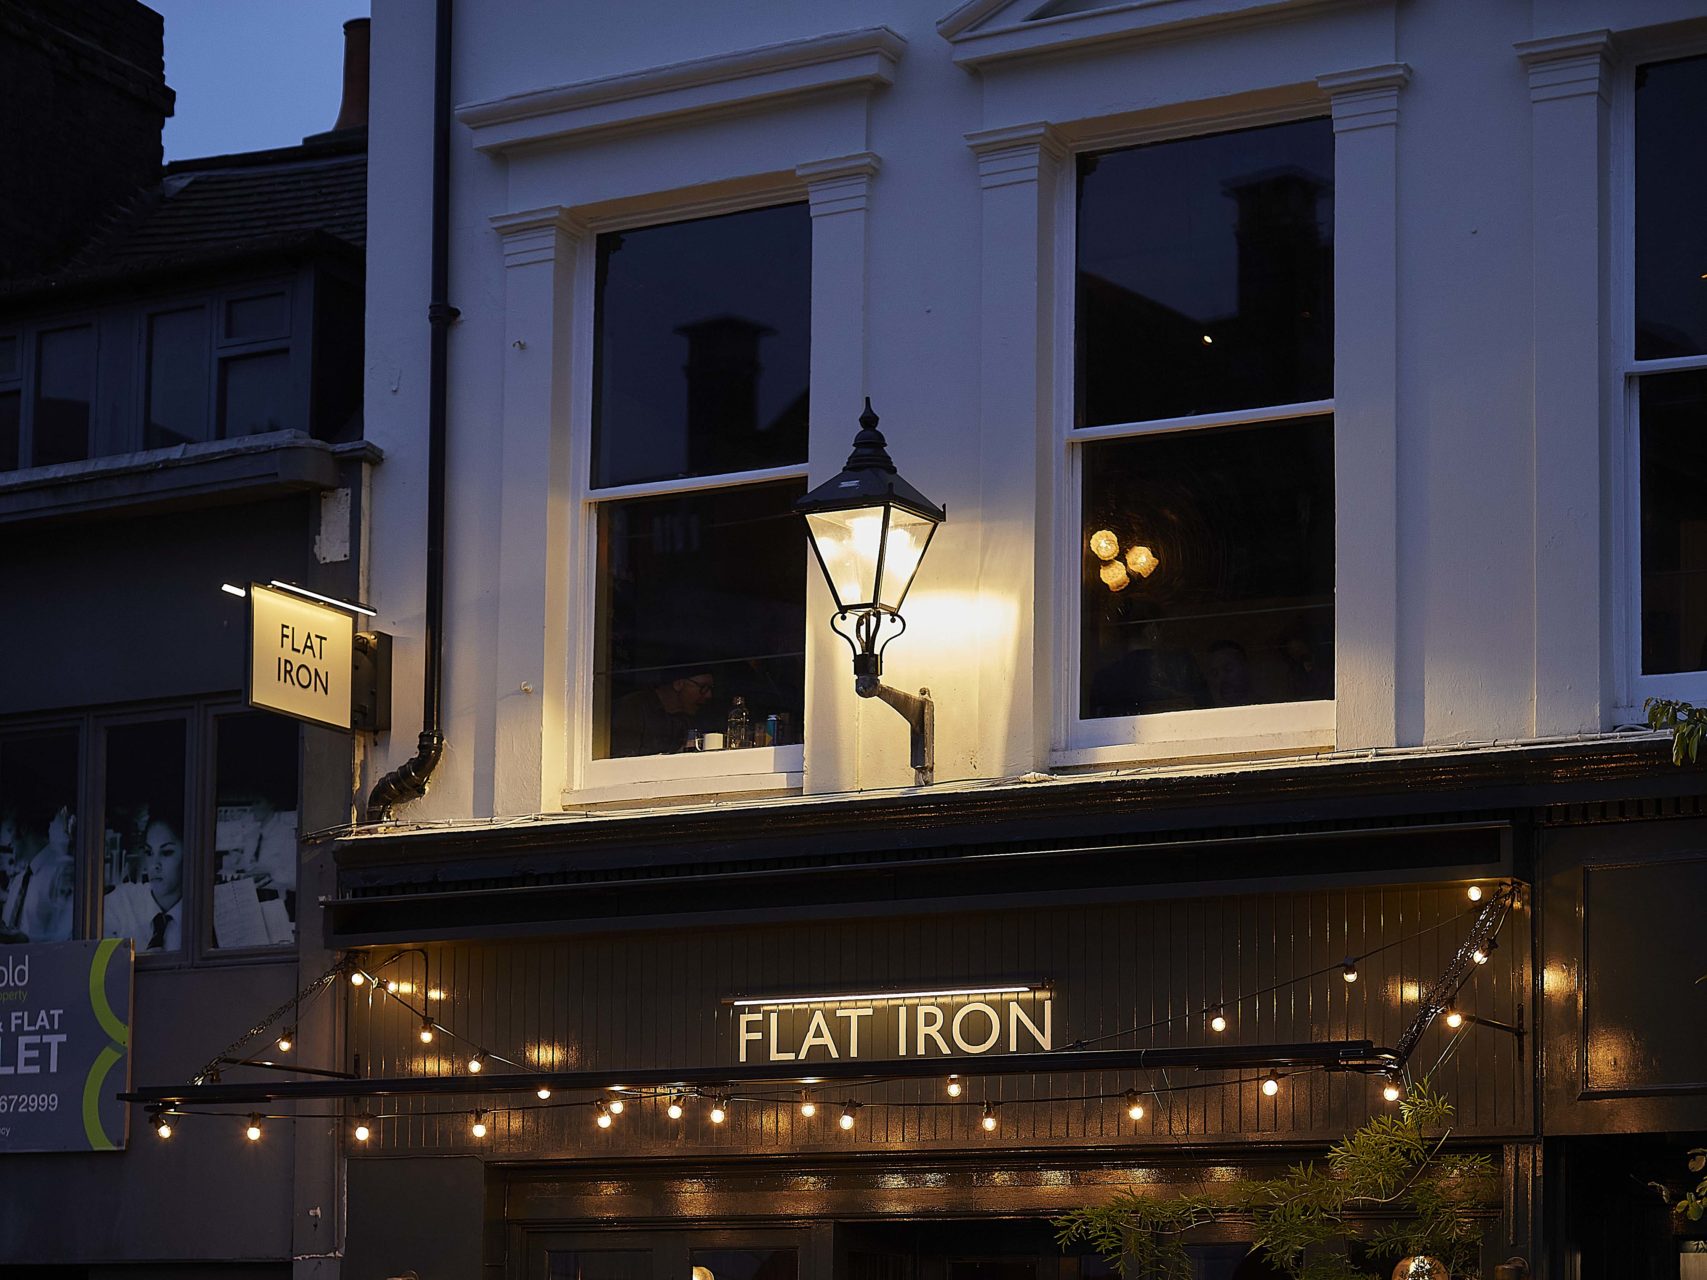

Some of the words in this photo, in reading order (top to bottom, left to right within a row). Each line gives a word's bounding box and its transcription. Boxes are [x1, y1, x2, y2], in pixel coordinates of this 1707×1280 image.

[281, 624, 327, 660] FLAT
[278, 657, 329, 696] IRON
[10, 1009, 64, 1032] FLAT
[739, 1008, 874, 1063] FLAT
[898, 1000, 1052, 1056] IRON
[0, 1034, 67, 1075] LET
